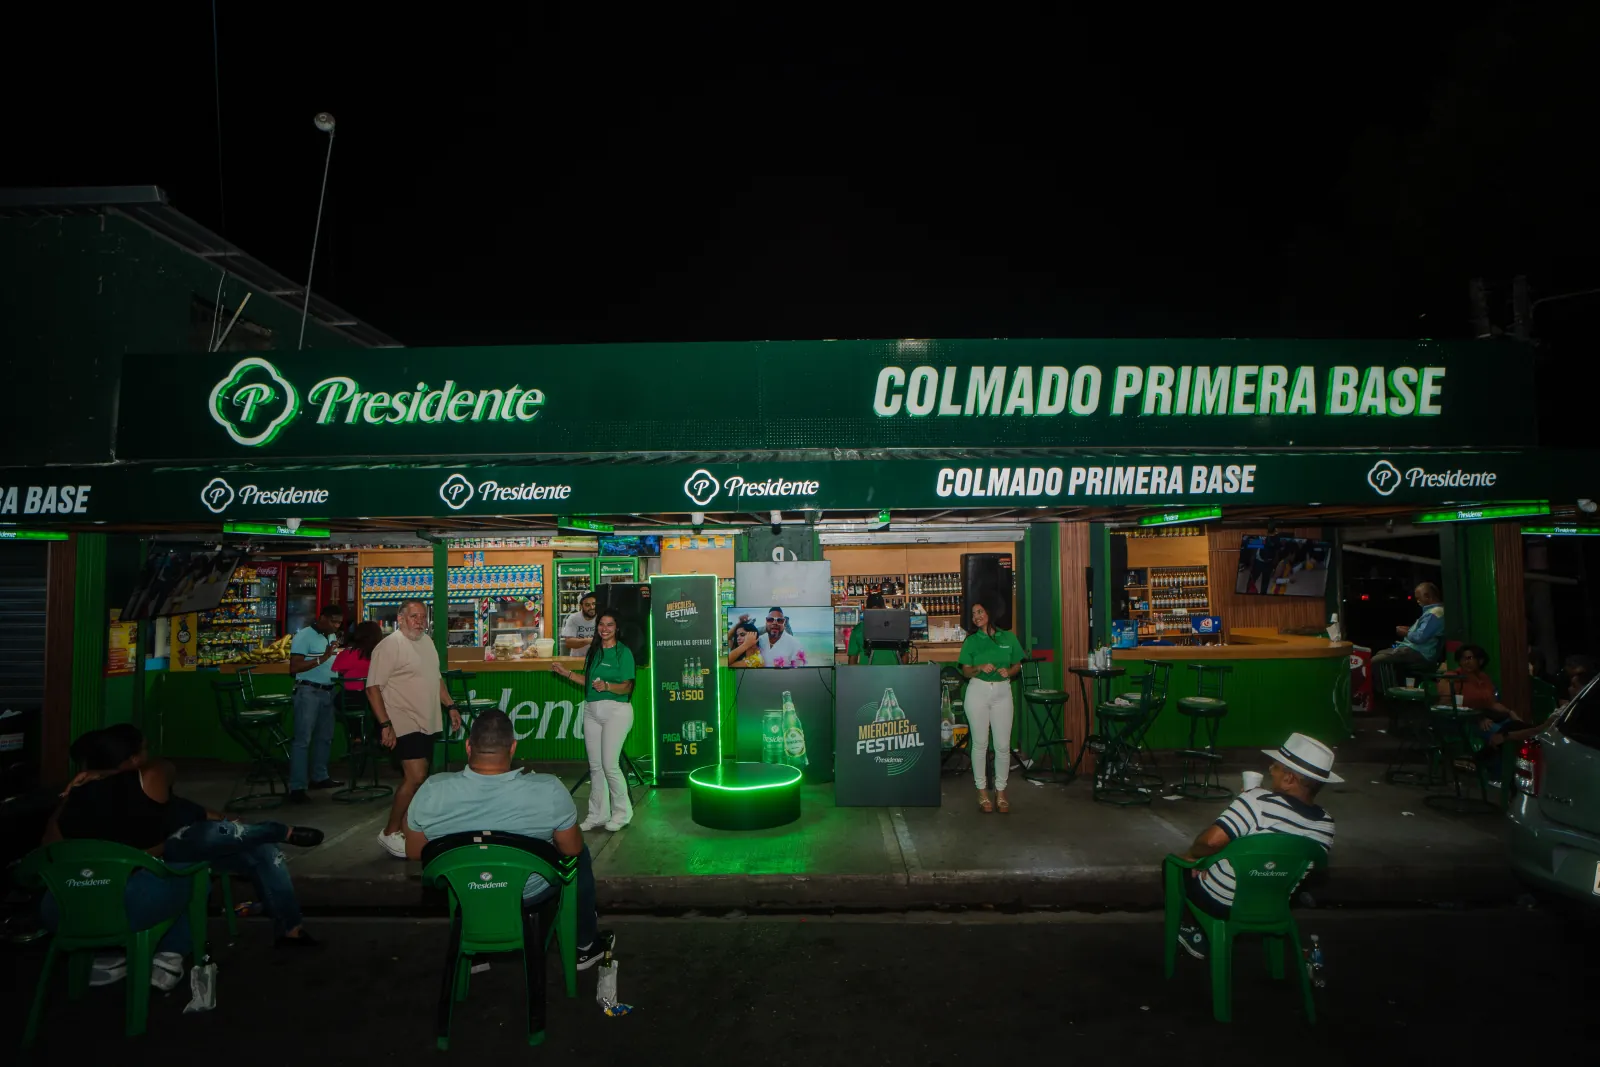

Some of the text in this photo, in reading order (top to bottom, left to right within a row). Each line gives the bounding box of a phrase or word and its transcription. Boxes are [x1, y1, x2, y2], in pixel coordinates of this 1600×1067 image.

[308, 376, 544, 424] Presidente
[873, 365, 1446, 417] COLMADO PRIMERA BASE
[723, 476, 820, 497] Presidente
[935, 464, 1257, 497] COLMADO PRIMERA BASE
[1405, 467, 1497, 487] Presidente
[24, 485, 92, 514] BASE
[238, 484, 329, 505] Presidente
[478, 480, 572, 501] Presidente
[665, 606, 698, 619] FESTIVAL
[661, 682, 680, 691] PAGA
[662, 733, 680, 742] PAGA
[858, 719, 918, 740] MIÉRCOLES DE
[856, 732, 925, 755] FESTIVAL
[65, 878, 111, 888] Presidente
[1248, 869, 1289, 877] Presidente
[467, 881, 508, 890] Presidente
